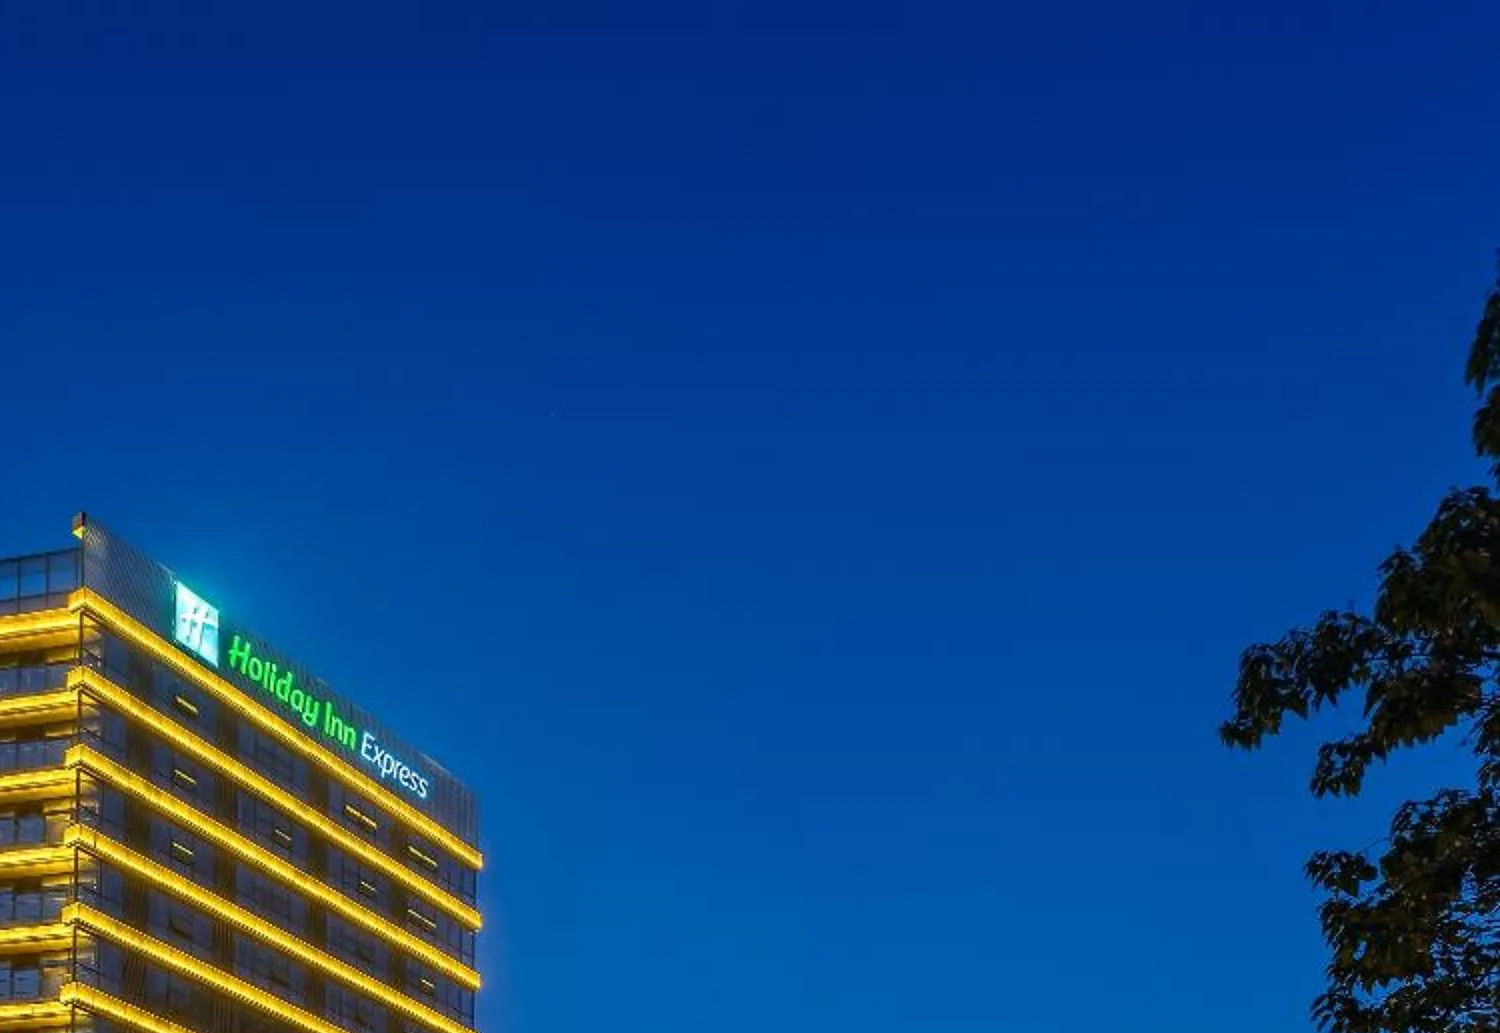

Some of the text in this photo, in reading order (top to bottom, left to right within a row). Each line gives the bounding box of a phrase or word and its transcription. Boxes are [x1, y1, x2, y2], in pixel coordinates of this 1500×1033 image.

[228, 634, 429, 799] Holiday Inn Express
